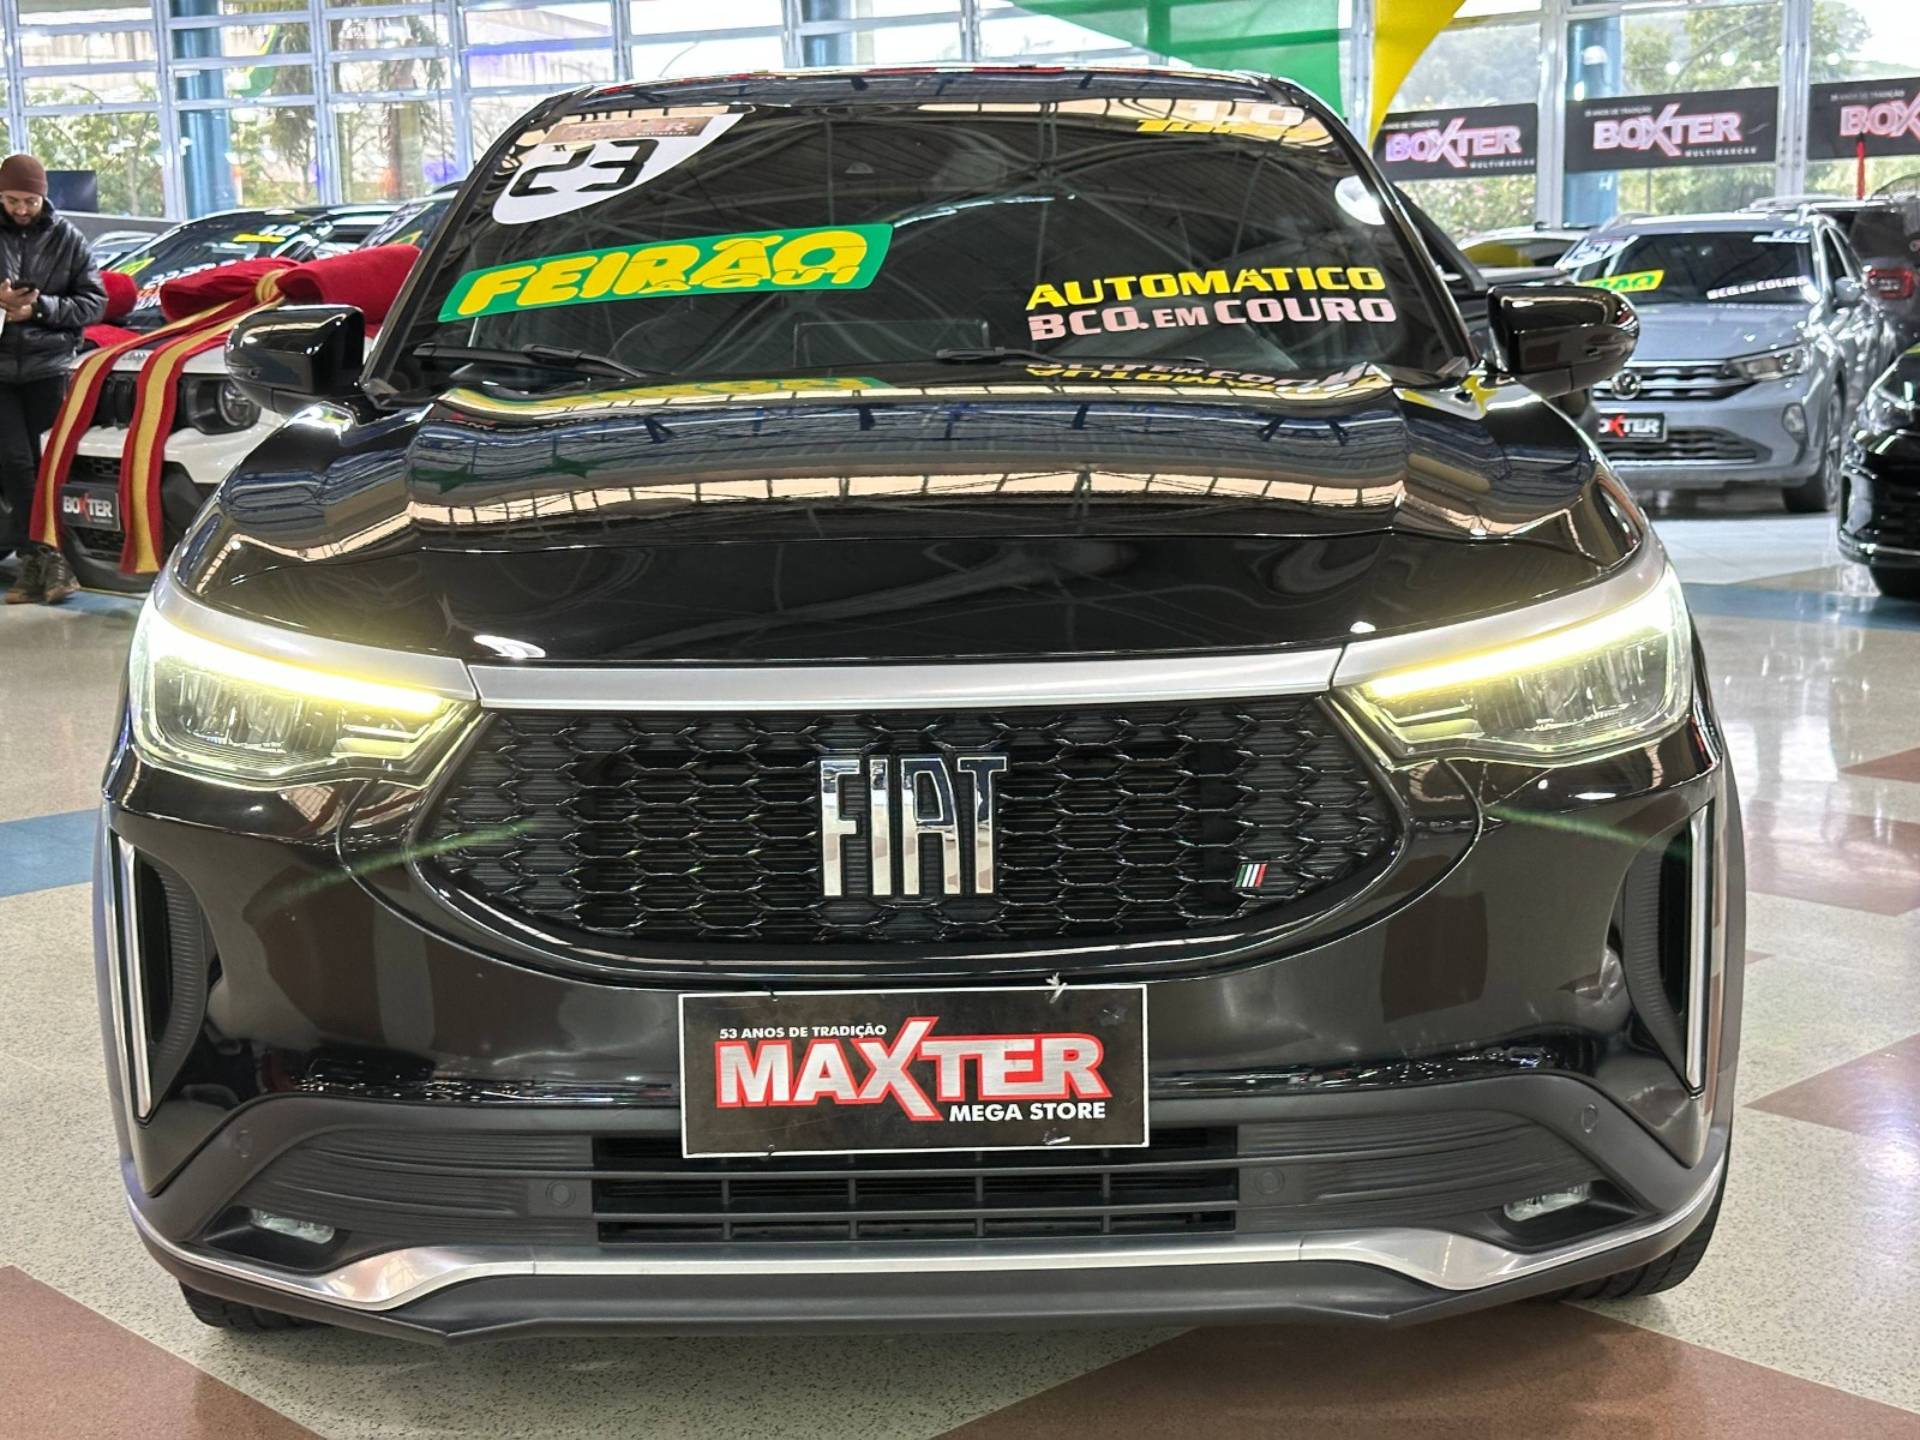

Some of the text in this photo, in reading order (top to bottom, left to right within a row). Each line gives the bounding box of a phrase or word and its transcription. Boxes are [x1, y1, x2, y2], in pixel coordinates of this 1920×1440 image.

[1593, 103, 1742, 156] BOXTER
[1840, 91, 1920, 142] BOX
[509, 139, 660, 197] 23
[1386, 117, 1522, 168] BOXTER
[457, 230, 868, 316] FEIRÃO
[1152, 305, 1209, 329] EM
[1213, 297, 1397, 324] COURO
[1599, 413, 1660, 438] OXTER
[63, 493, 113, 522] BOXTER
[820, 756, 1007, 897] FIAT
[719, 1022, 887, 1039] 53 ANOS DE TRADIÇÃO
[714, 1016, 1112, 1121] MAXTER
[950, 1101, 1106, 1122] MEGA STORE
